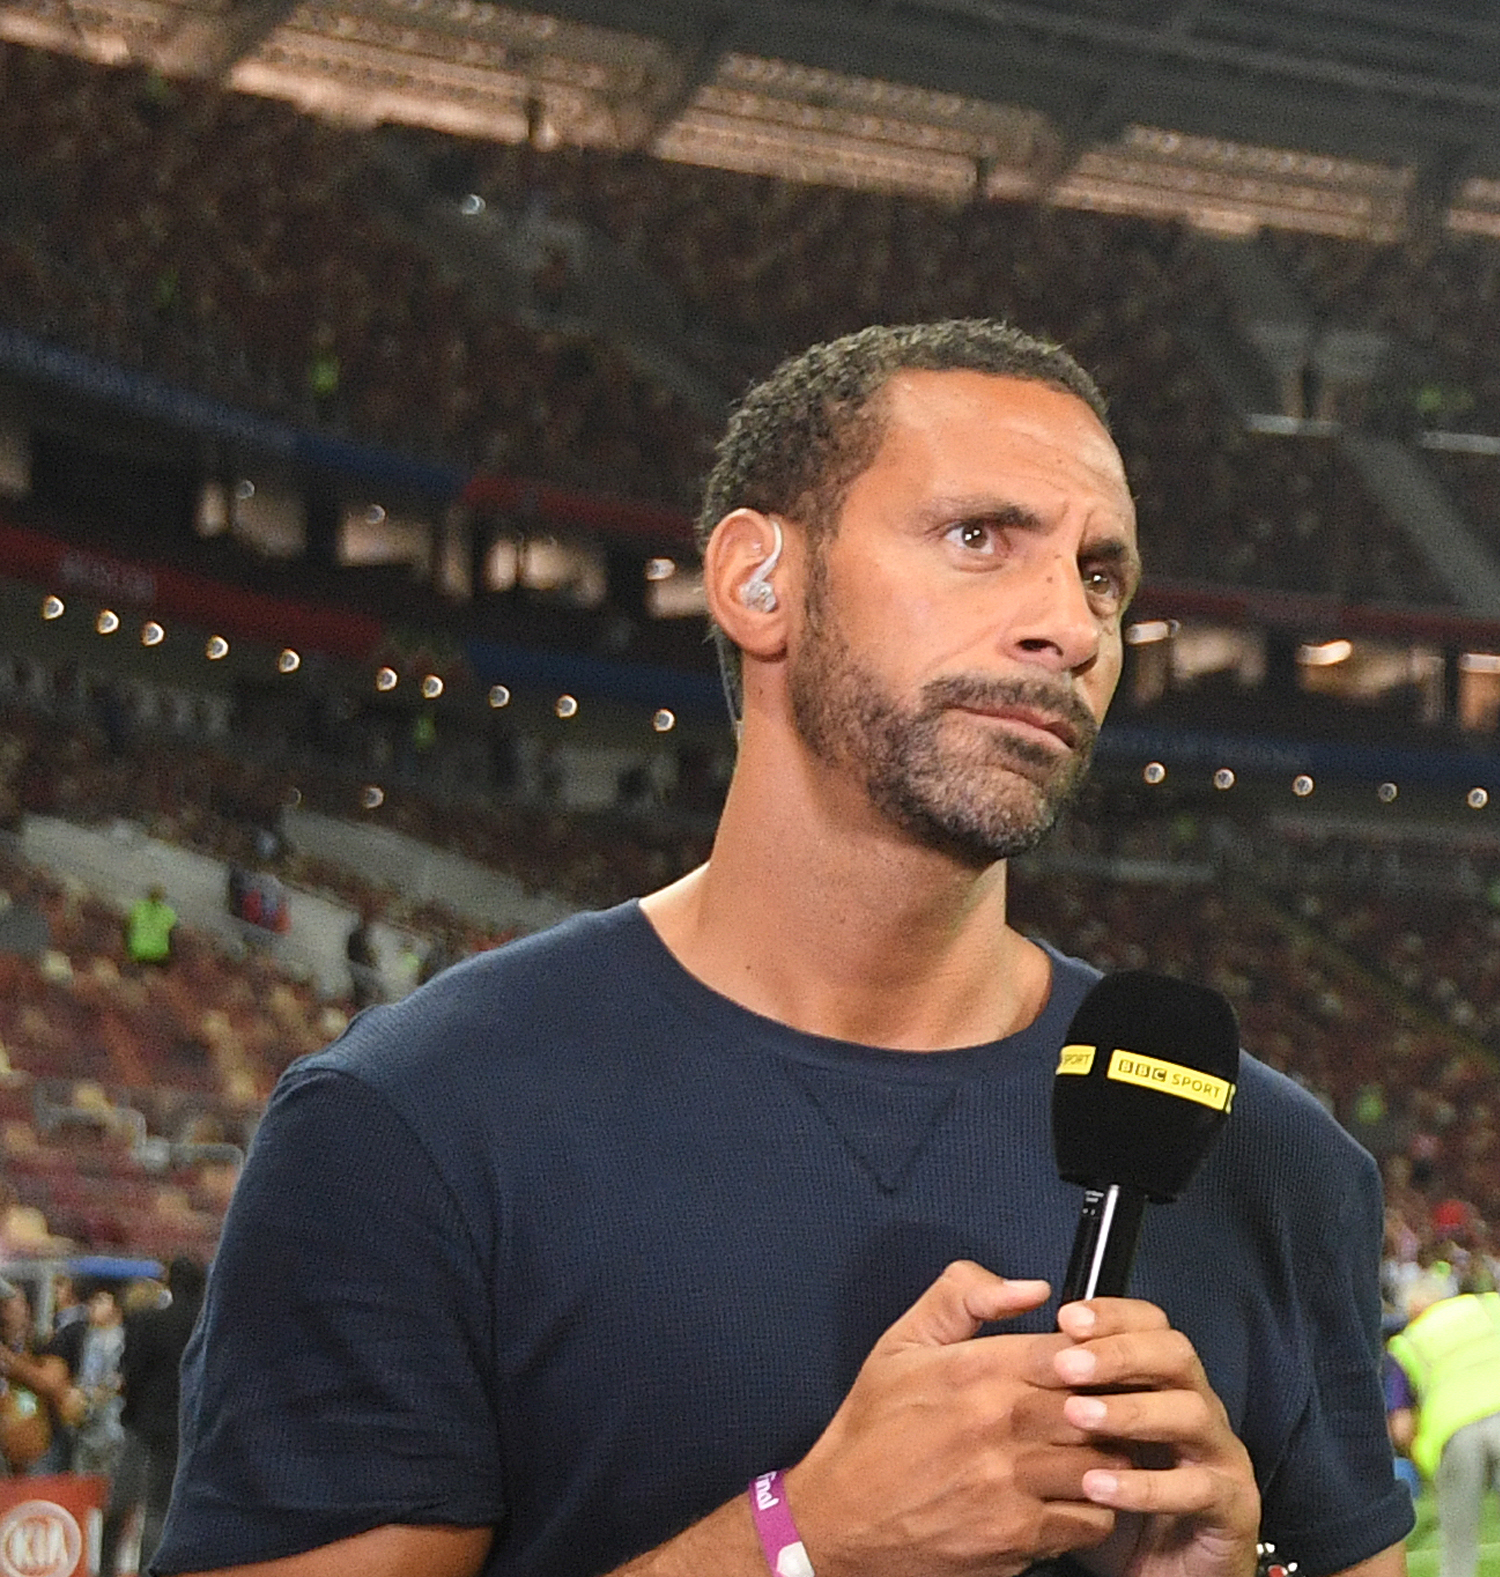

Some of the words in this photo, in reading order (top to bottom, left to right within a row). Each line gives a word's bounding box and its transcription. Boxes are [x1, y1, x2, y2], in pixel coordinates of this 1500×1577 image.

[1063, 1053, 1091, 1066] PORT
[1118, 1059, 1167, 1082] BBC
[1171, 1073, 1221, 1098] SPORT
